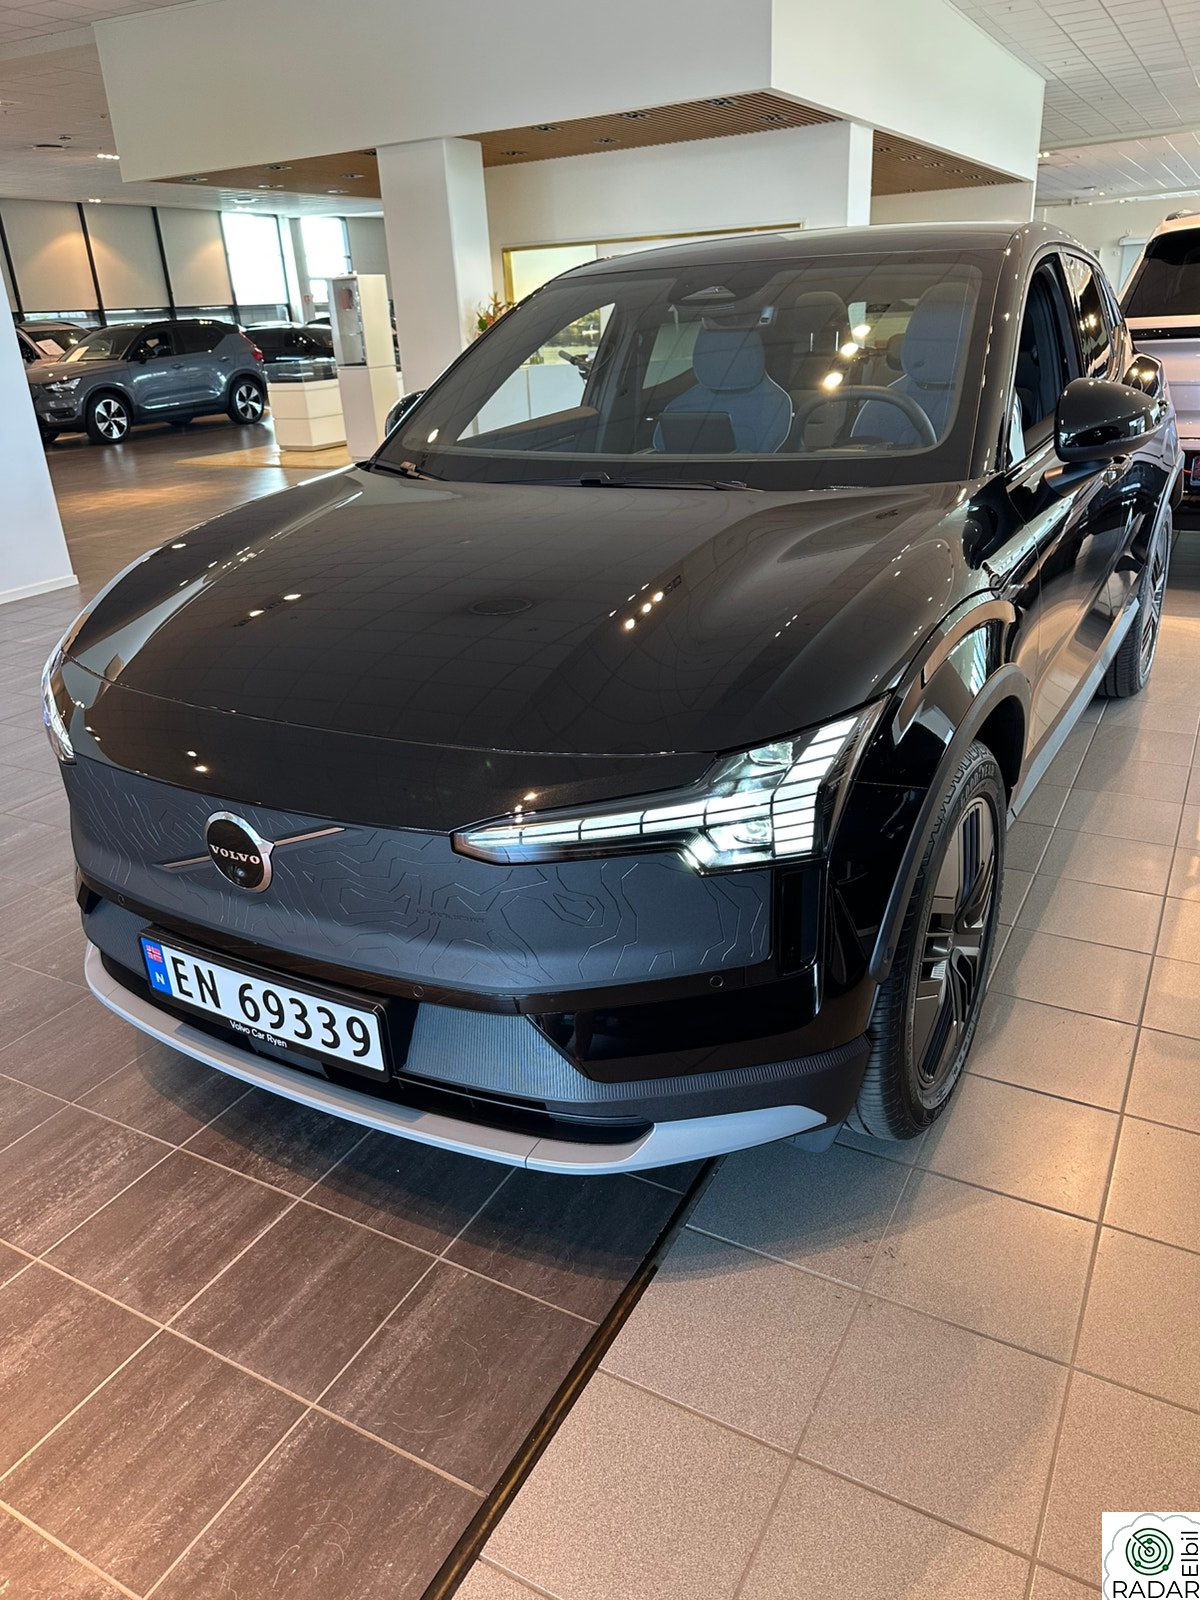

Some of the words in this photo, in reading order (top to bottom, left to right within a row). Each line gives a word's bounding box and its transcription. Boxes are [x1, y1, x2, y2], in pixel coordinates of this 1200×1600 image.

[209, 843, 261, 865] VOLVO
[155, 972, 165, 985] N
[171, 956, 222, 1010] EN
[238, 983, 371, 1057] 69339
[229, 1019, 251, 1035] Volvo
[251, 1028, 265, 1040] Car
[266, 1033, 288, 1048] Ryen
